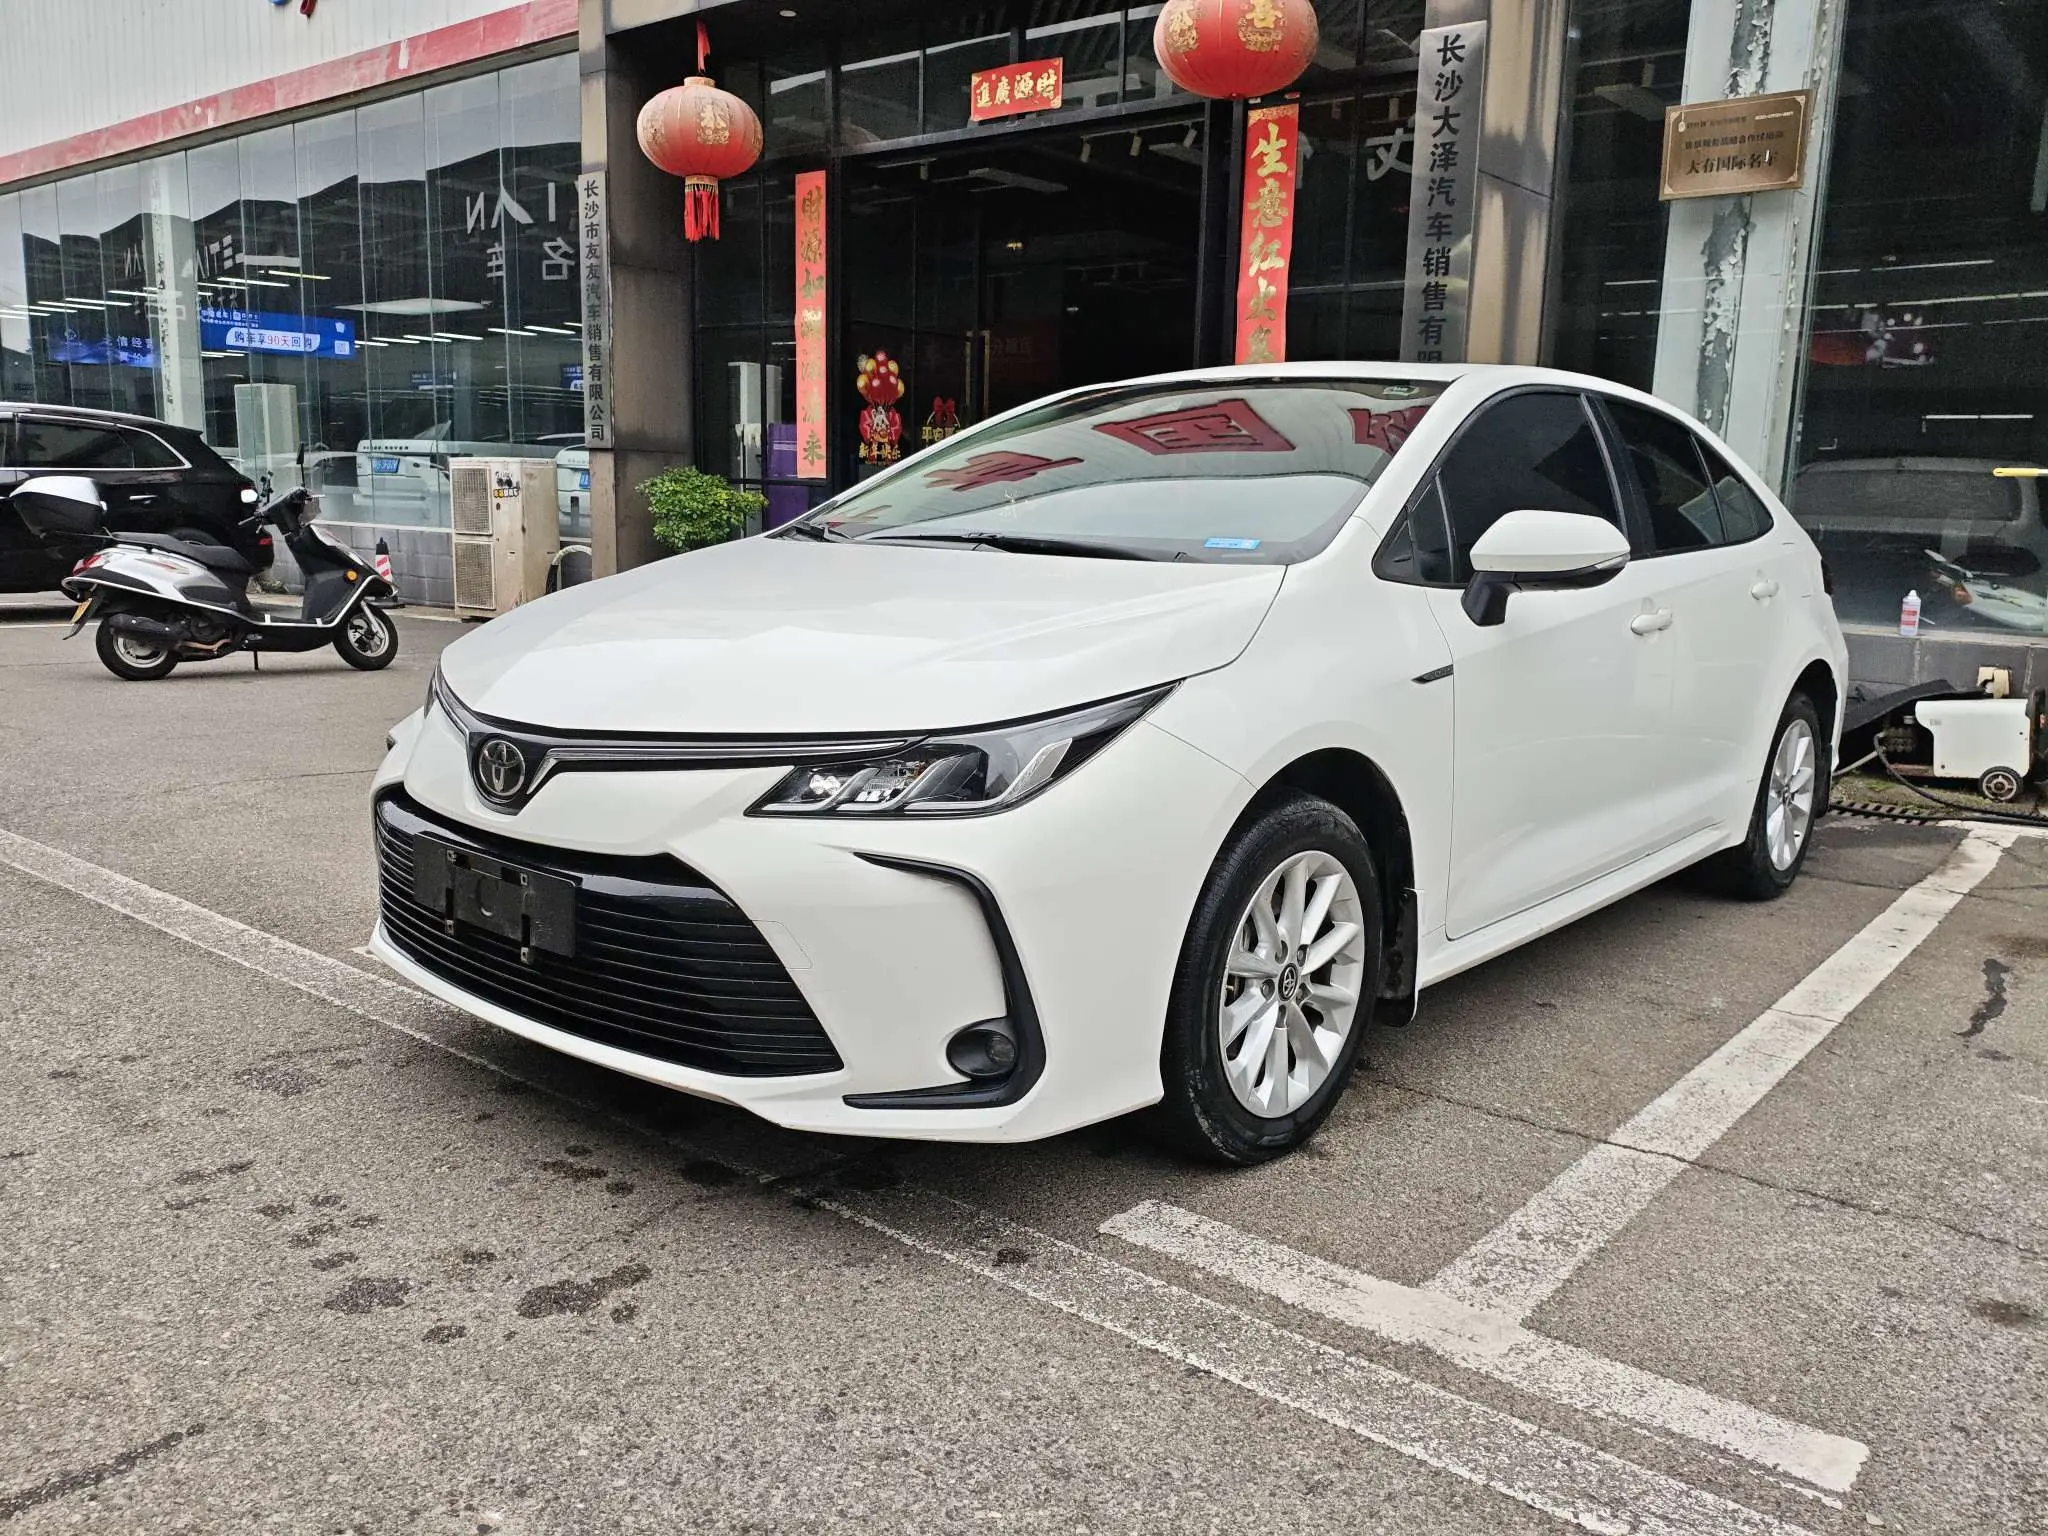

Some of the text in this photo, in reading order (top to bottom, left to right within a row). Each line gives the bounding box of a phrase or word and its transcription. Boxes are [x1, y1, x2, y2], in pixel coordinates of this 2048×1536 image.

[583, 179, 606, 441] 长沙市友友汽车销售有限公司
[1416, 33, 1466, 362] 长沙大泽汽车销售有限
